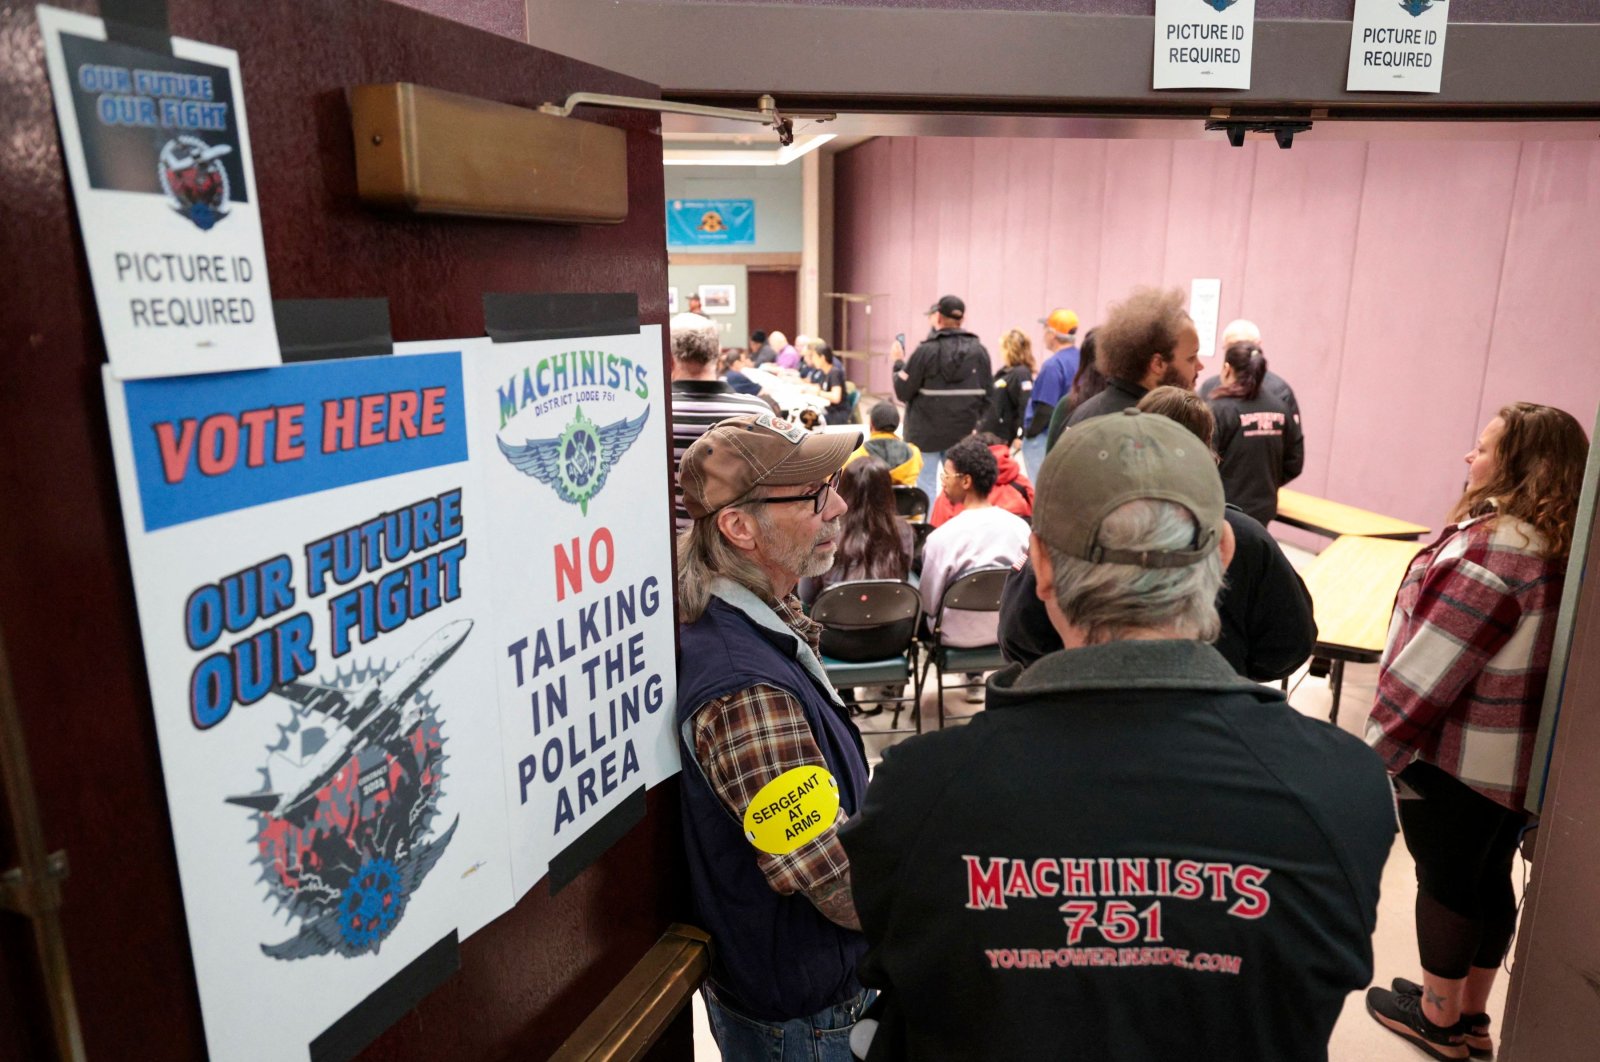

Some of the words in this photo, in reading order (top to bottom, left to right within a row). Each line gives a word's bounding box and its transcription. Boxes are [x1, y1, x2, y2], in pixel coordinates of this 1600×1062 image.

[1167, 24, 1228, 40] PICTURE
[1232, 25, 1244, 40] ID
[1363, 28, 1421, 45] PICTURE
[1425, 30, 1437, 45] ID
[1169, 47, 1241, 63] REQUIRED
[1363, 51, 1432, 67] REQUIRED
[79, 64, 131, 94] OUR
[134, 69, 213, 101] FUTURE
[97, 96, 157, 126] OUR
[160, 100, 227, 130] FIGHT
[115, 252, 228, 283] PICTURE
[234, 256, 252, 283] ID
[130, 298, 255, 327] REQUIRED
[496, 350, 649, 431] MACHINISTS
[534, 394, 573, 418] DISTRICT
[576, 390, 600, 403] LODGE
[602, 391, 615, 402] 751
[154, 403, 305, 484] VOTE
[321, 386, 447, 454] HERE
[184, 553, 296, 652] OUR
[304, 487, 463, 599] FUTURE
[553, 526, 615, 602] NO
[189, 611, 316, 730] OUR
[328, 538, 467, 658] FIGHT
[508, 575, 660, 688] TALKING
[531, 674, 568, 737] IN
[582, 631, 645, 701] THE
[518, 673, 663, 806] POLLING
[553, 738, 640, 836] AREA
[752, 773, 820, 824] SERGEANT
[785, 809, 821, 841] ARMS
[788, 803, 804, 822] AT
[962, 855, 1271, 919] MACHINISTS
[1058, 900, 1164, 945] 751
[985, 947, 1243, 974] YOURPOWERINSIDE.COM
